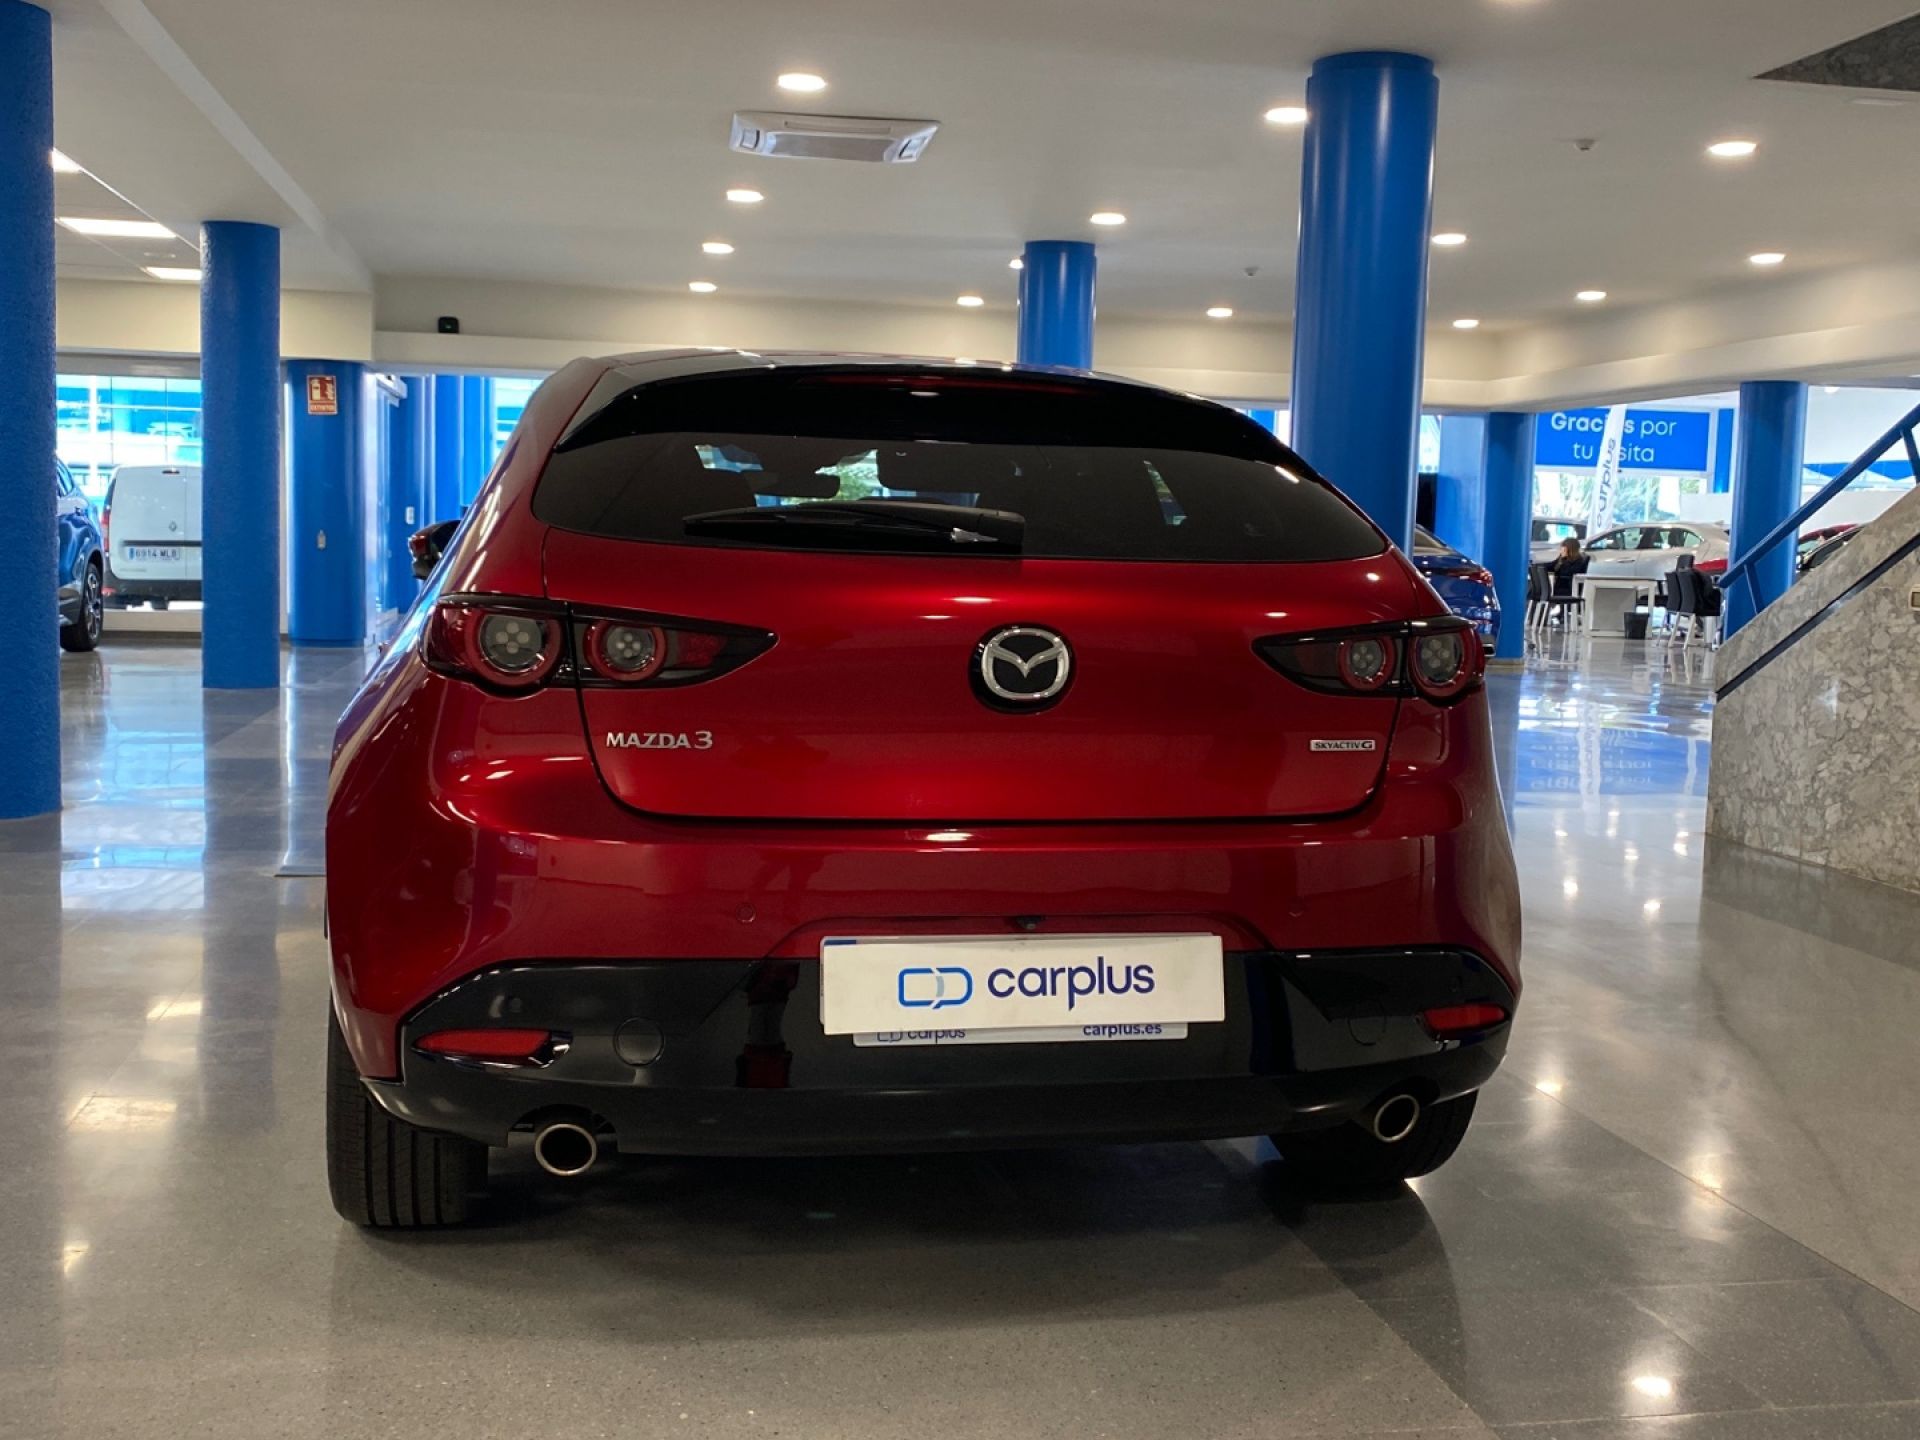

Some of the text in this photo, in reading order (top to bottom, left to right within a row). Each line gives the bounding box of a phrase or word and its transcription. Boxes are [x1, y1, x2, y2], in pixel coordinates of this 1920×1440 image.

[1551, 412, 1677, 439] Gracs por
[1573, 442, 1655, 462] tu sita
[1596, 437, 1617, 529] carplus
[987, 956, 1155, 1011] carplus
[1083, 1023, 1162, 1037] carplus.es
